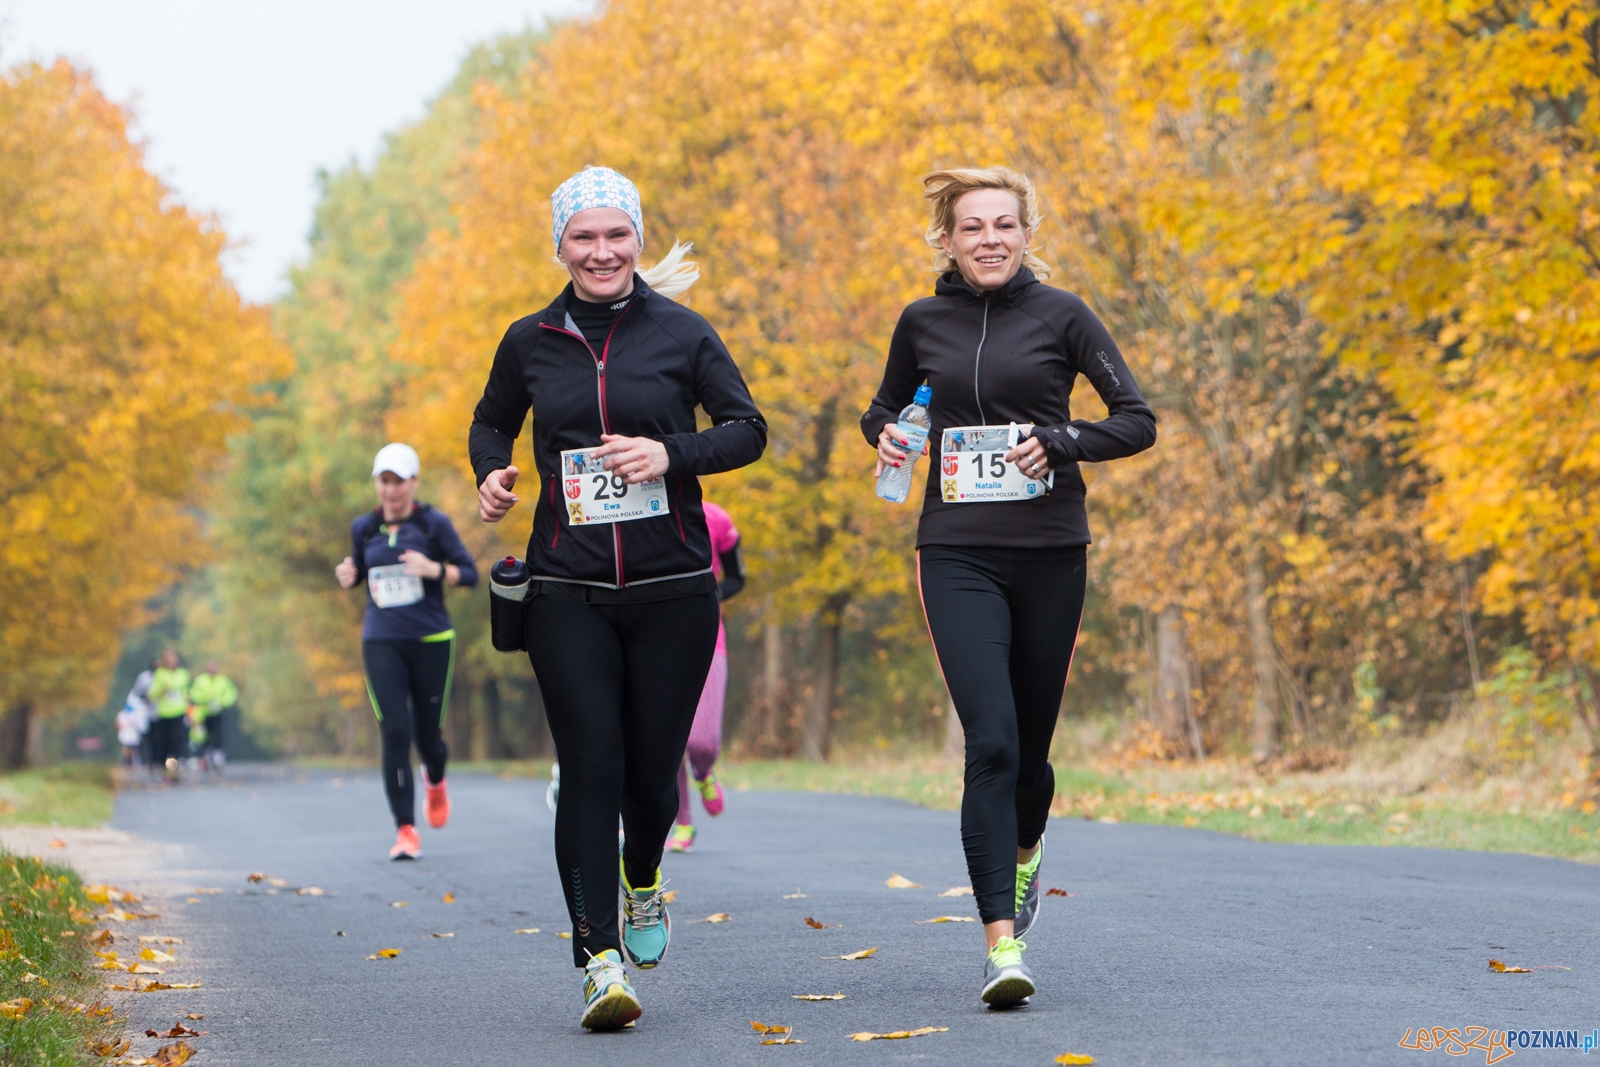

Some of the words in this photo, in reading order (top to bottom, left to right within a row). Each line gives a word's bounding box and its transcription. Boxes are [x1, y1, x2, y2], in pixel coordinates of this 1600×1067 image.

[972, 453, 1006, 479] 15
[592, 474, 628, 501] 29
[604, 503, 621, 511] Ewa
[620, 510, 643, 518] POLSKA
